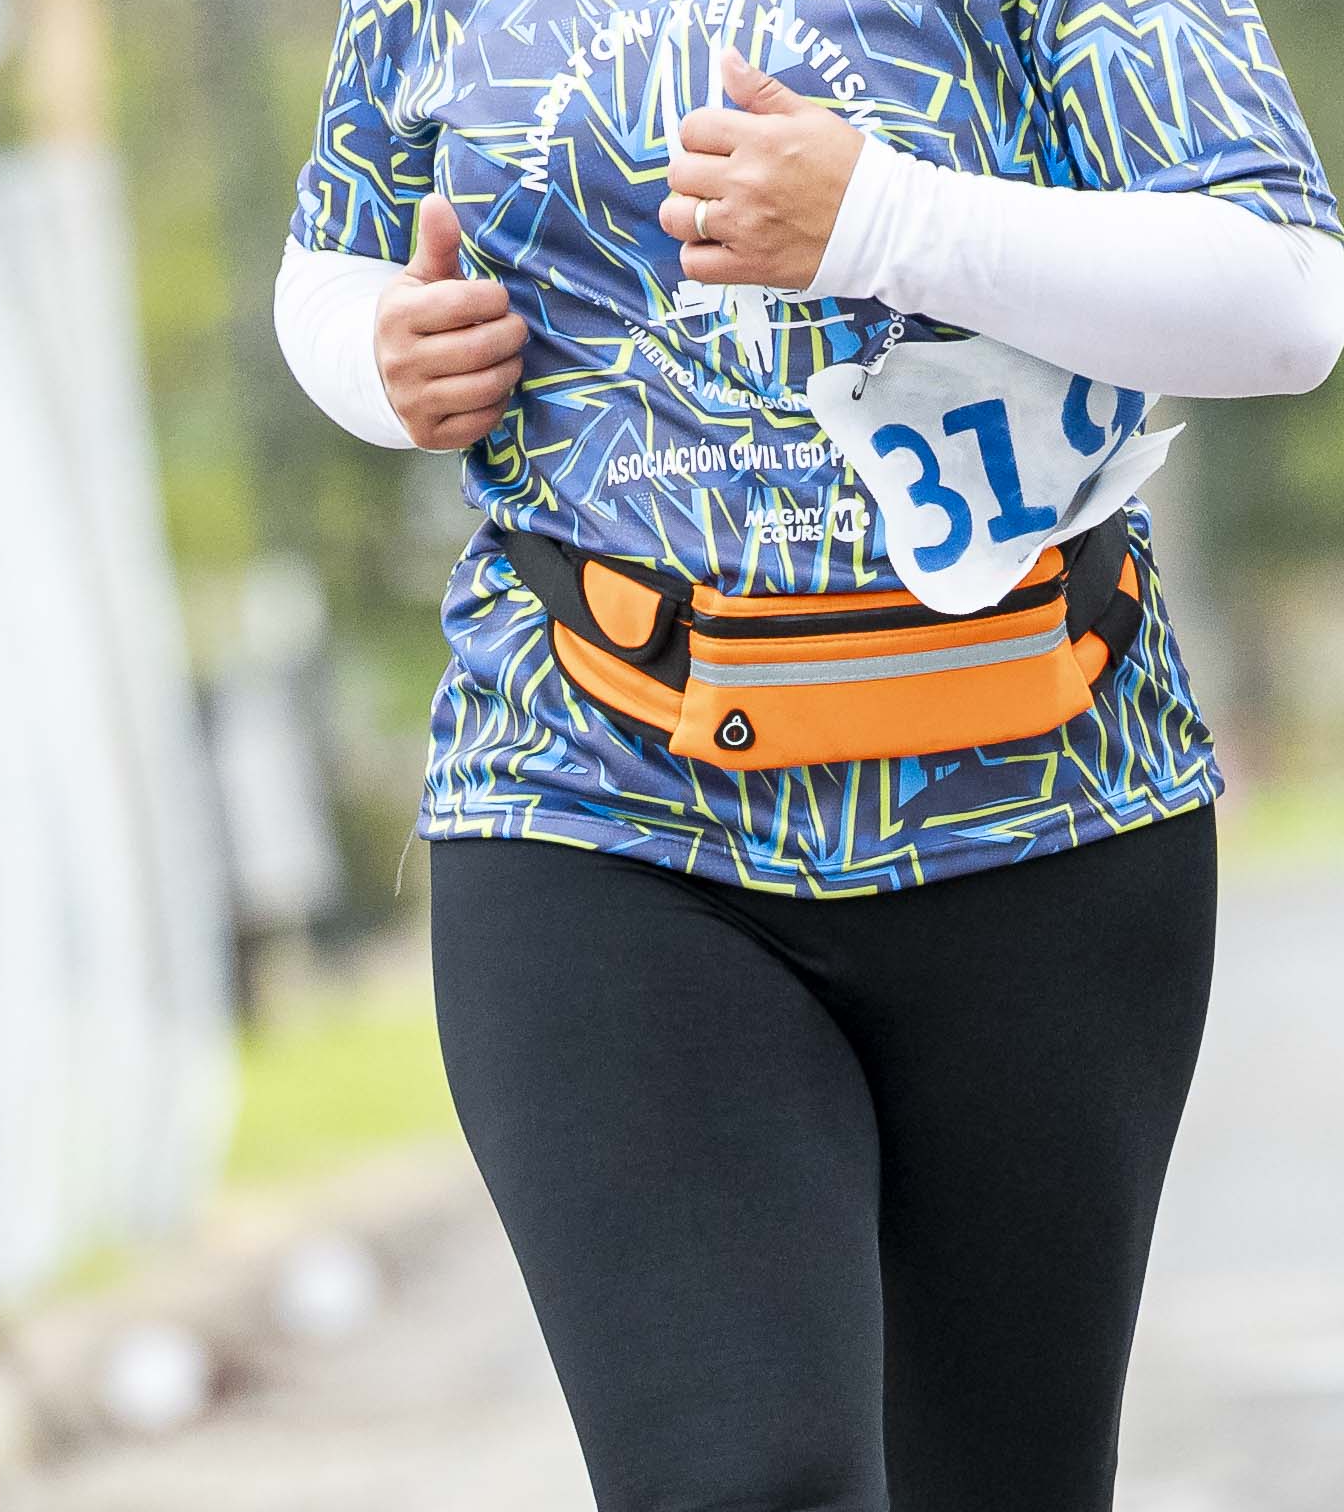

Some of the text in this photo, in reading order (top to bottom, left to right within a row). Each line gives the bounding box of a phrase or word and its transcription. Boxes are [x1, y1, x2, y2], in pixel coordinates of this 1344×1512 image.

[753, 5, 882, 131] AUTISM
[607, 437, 727, 487] ASOCIACIÓN
[729, 444, 782, 471] CIVIL
[783, 441, 825, 471] TGD
[744, 506, 825, 528] MAGNY
[758, 523, 825, 544] COURS
